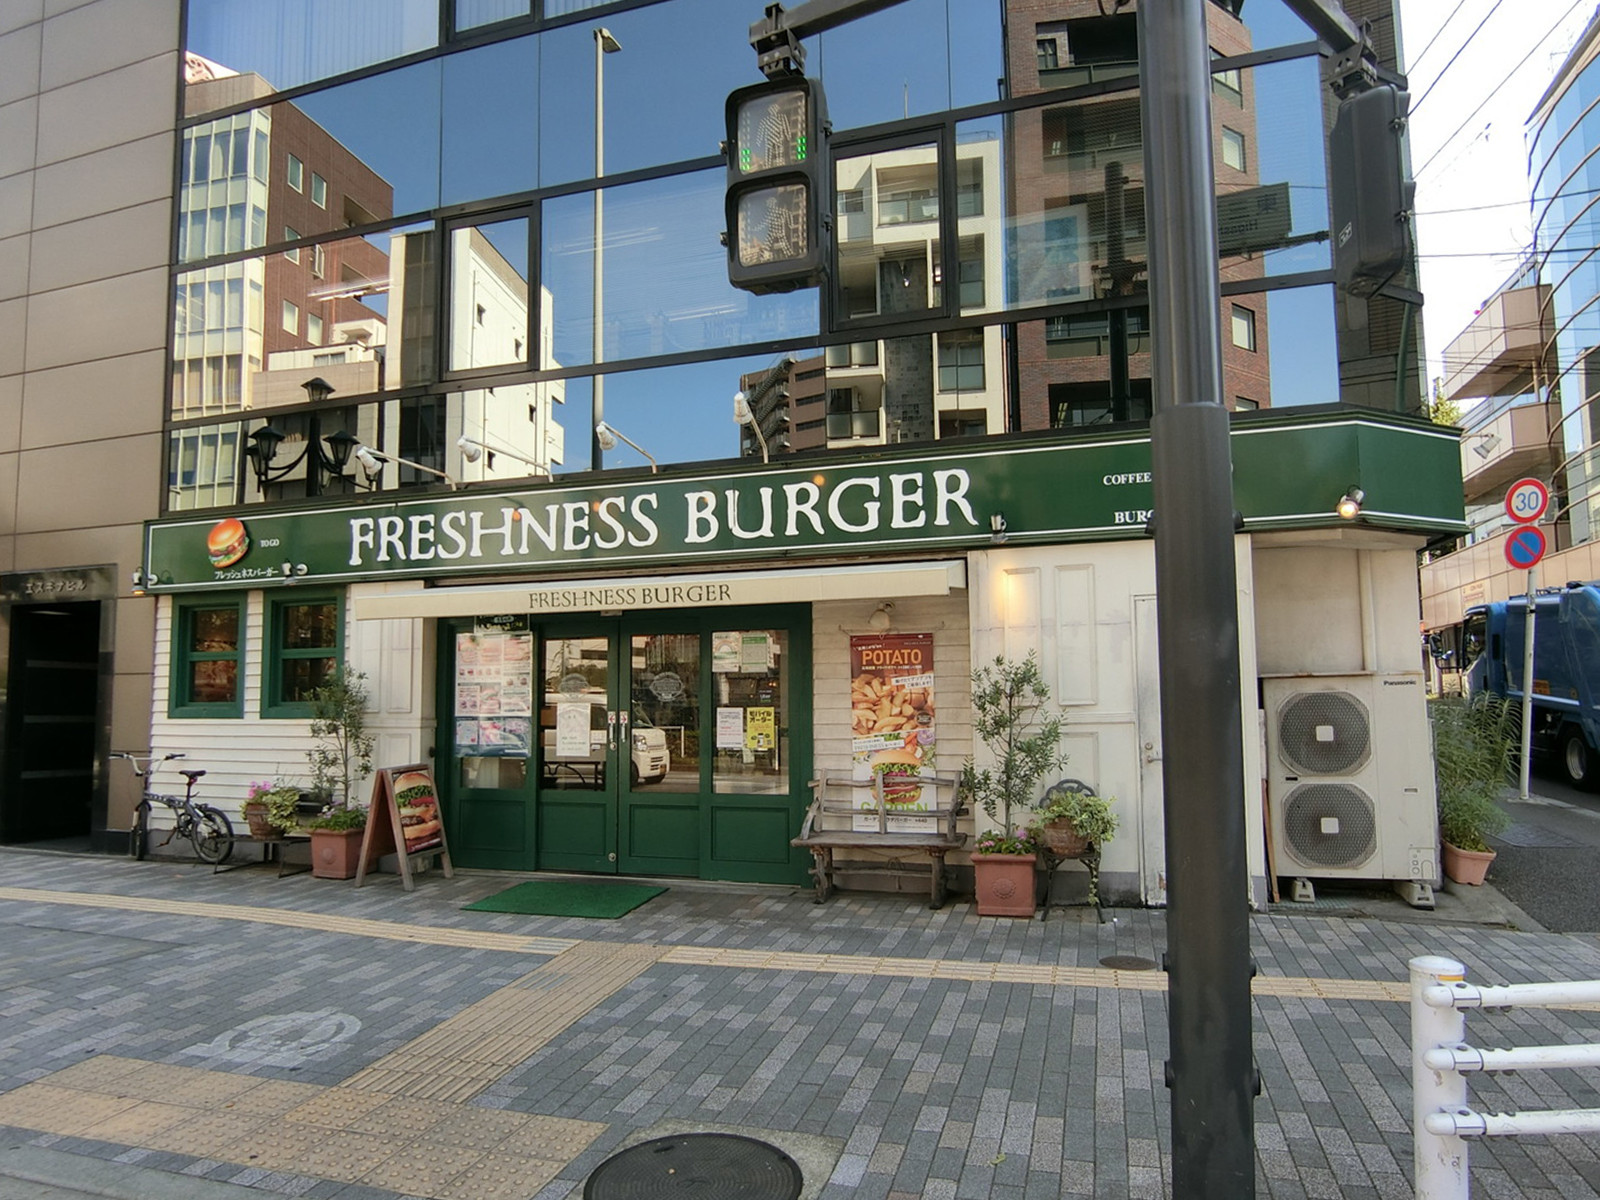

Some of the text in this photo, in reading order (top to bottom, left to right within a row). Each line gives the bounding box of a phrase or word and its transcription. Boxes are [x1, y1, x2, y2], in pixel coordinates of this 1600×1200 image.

[1103, 472, 1152, 486] COFFEE
[1515, 491, 1539, 512] 30
[348, 468, 980, 566] FRESHNESS BURGER
[214, 567, 279, 580] フレッシュネスバーガー
[528, 584, 732, 608] FRESHNESS BURGER
[862, 649, 922, 665] POTATO
